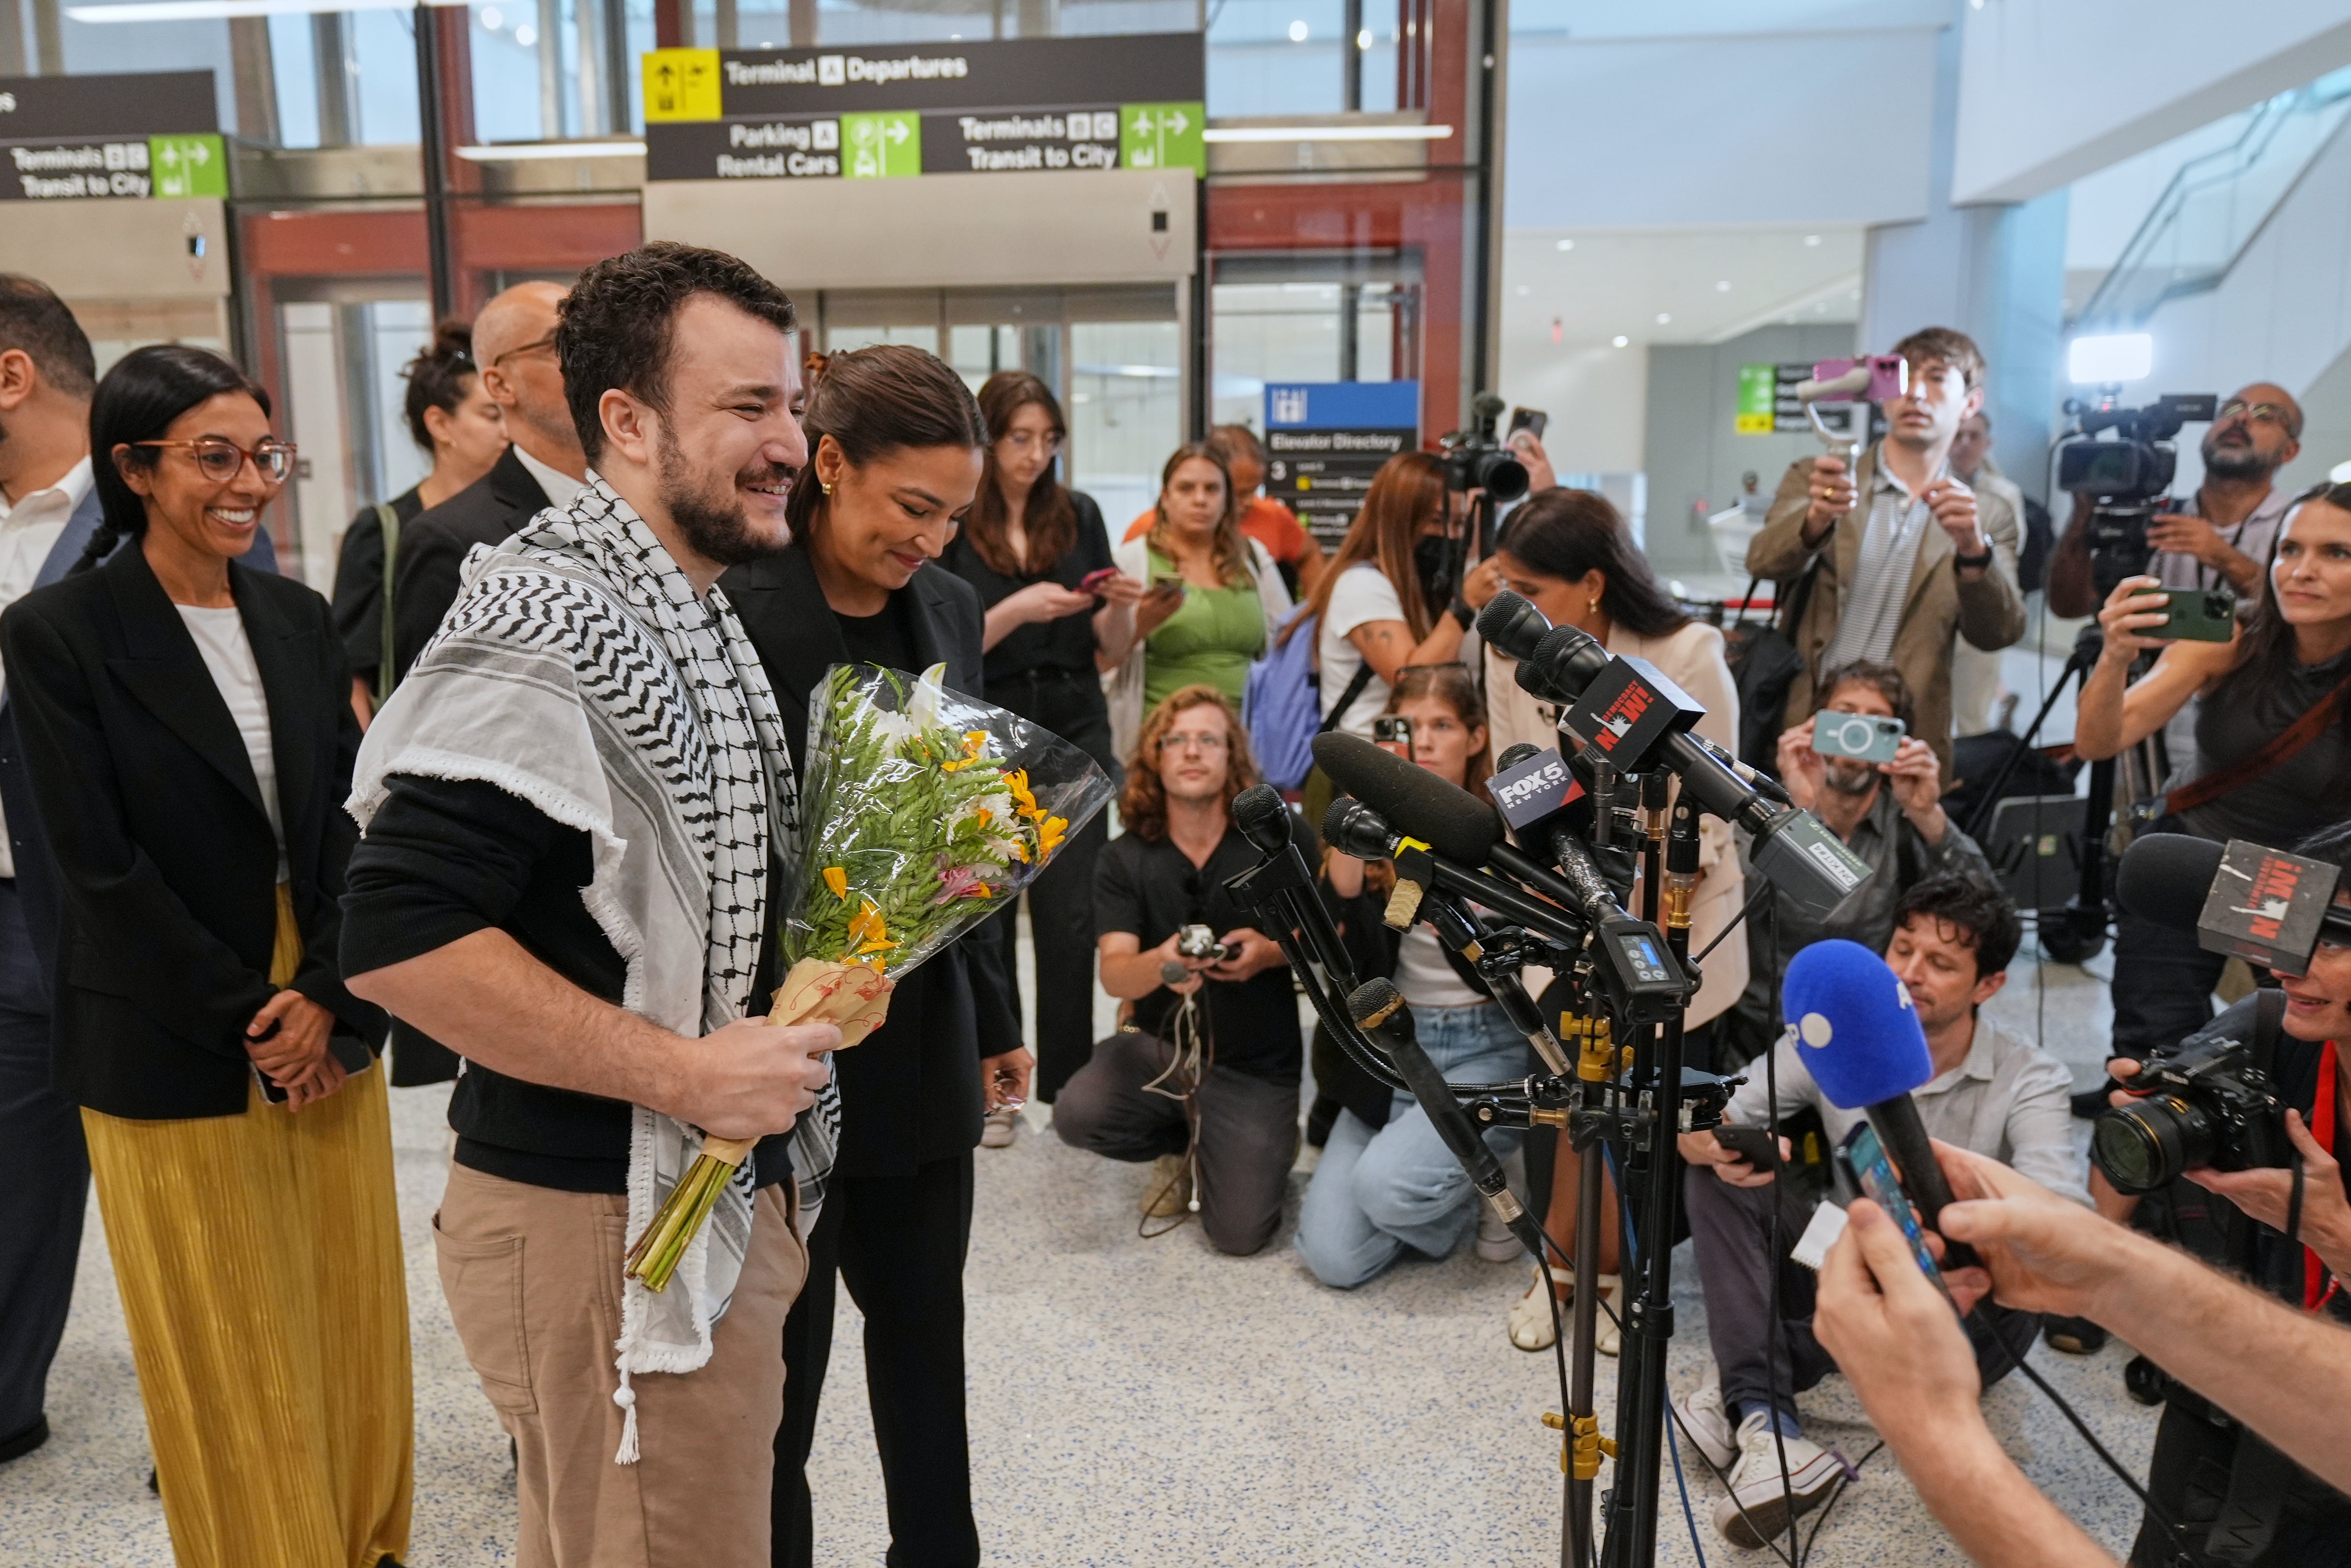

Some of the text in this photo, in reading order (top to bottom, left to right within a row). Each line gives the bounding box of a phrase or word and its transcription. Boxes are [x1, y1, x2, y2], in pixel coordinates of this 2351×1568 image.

[724, 59, 816, 84] Terminal
[846, 55, 968, 85] Departures
[730, 123, 811, 151] Parking
[959, 115, 1065, 141] Terminals
[10, 145, 104, 171] Terminals
[717, 152, 839, 177] Rental Cars
[966, 143, 1117, 170] Transit to City
[20, 171, 151, 199] Transit to City
[1271, 433, 1402, 452] Elevator Directory
[1271, 460, 1287, 481] 3
[1602, 680, 1639, 722] DEMOCRACY
[1498, 770, 1549, 804] FOX
[1506, 775, 1568, 809] NEW YORK
[1838, 870, 1855, 884] DN
